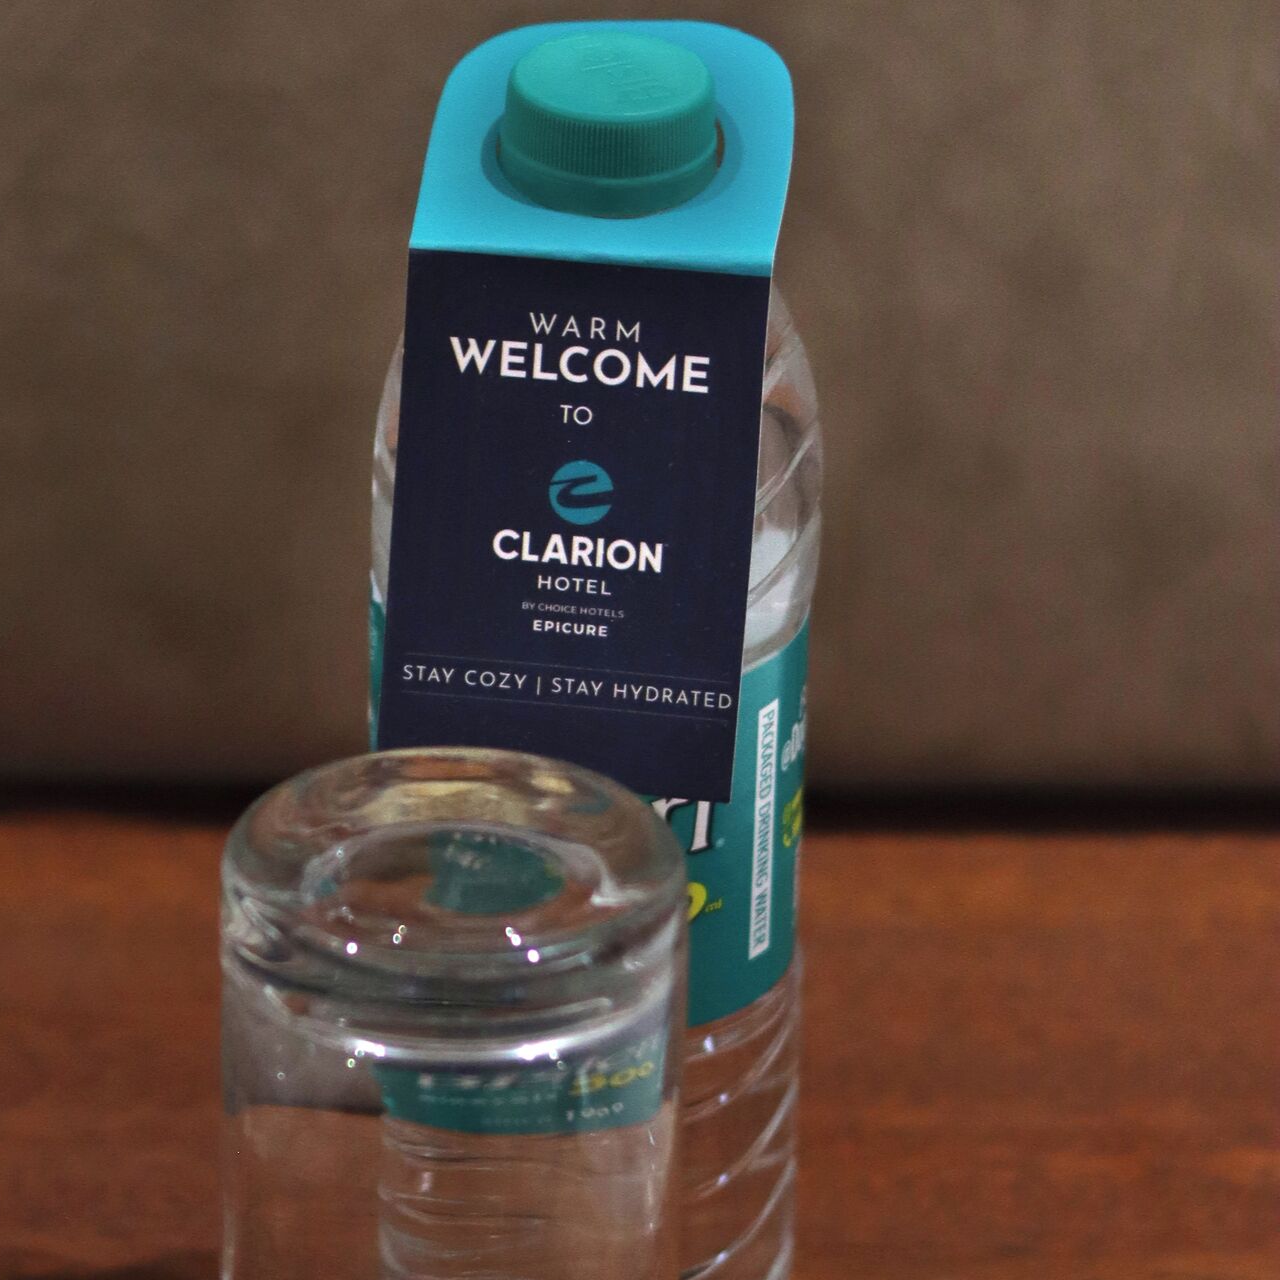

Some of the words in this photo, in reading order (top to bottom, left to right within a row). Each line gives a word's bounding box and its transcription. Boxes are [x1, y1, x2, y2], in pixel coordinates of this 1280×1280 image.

[528, 311, 641, 344] WARM
[449, 335, 710, 394] WELCOME
[559, 404, 593, 426] TO
[492, 528, 664, 573] CLARION
[537, 575, 612, 596] HOTEL
[521, 601, 536, 611] BY
[537, 602, 577, 614] CHOICE
[579, 606, 625, 619] HOTELS
[532, 619, 608, 637] EPICURE
[402, 664, 455, 683] STAY
[464, 669, 527, 689] COZY
[551, 677, 603, 696] STAY
[613, 683, 732, 709] HYDRATED
[760, 709, 775, 800] PACKAGED
[756, 801, 772, 888] DRINKING
[754, 888, 769, 948] WATER
